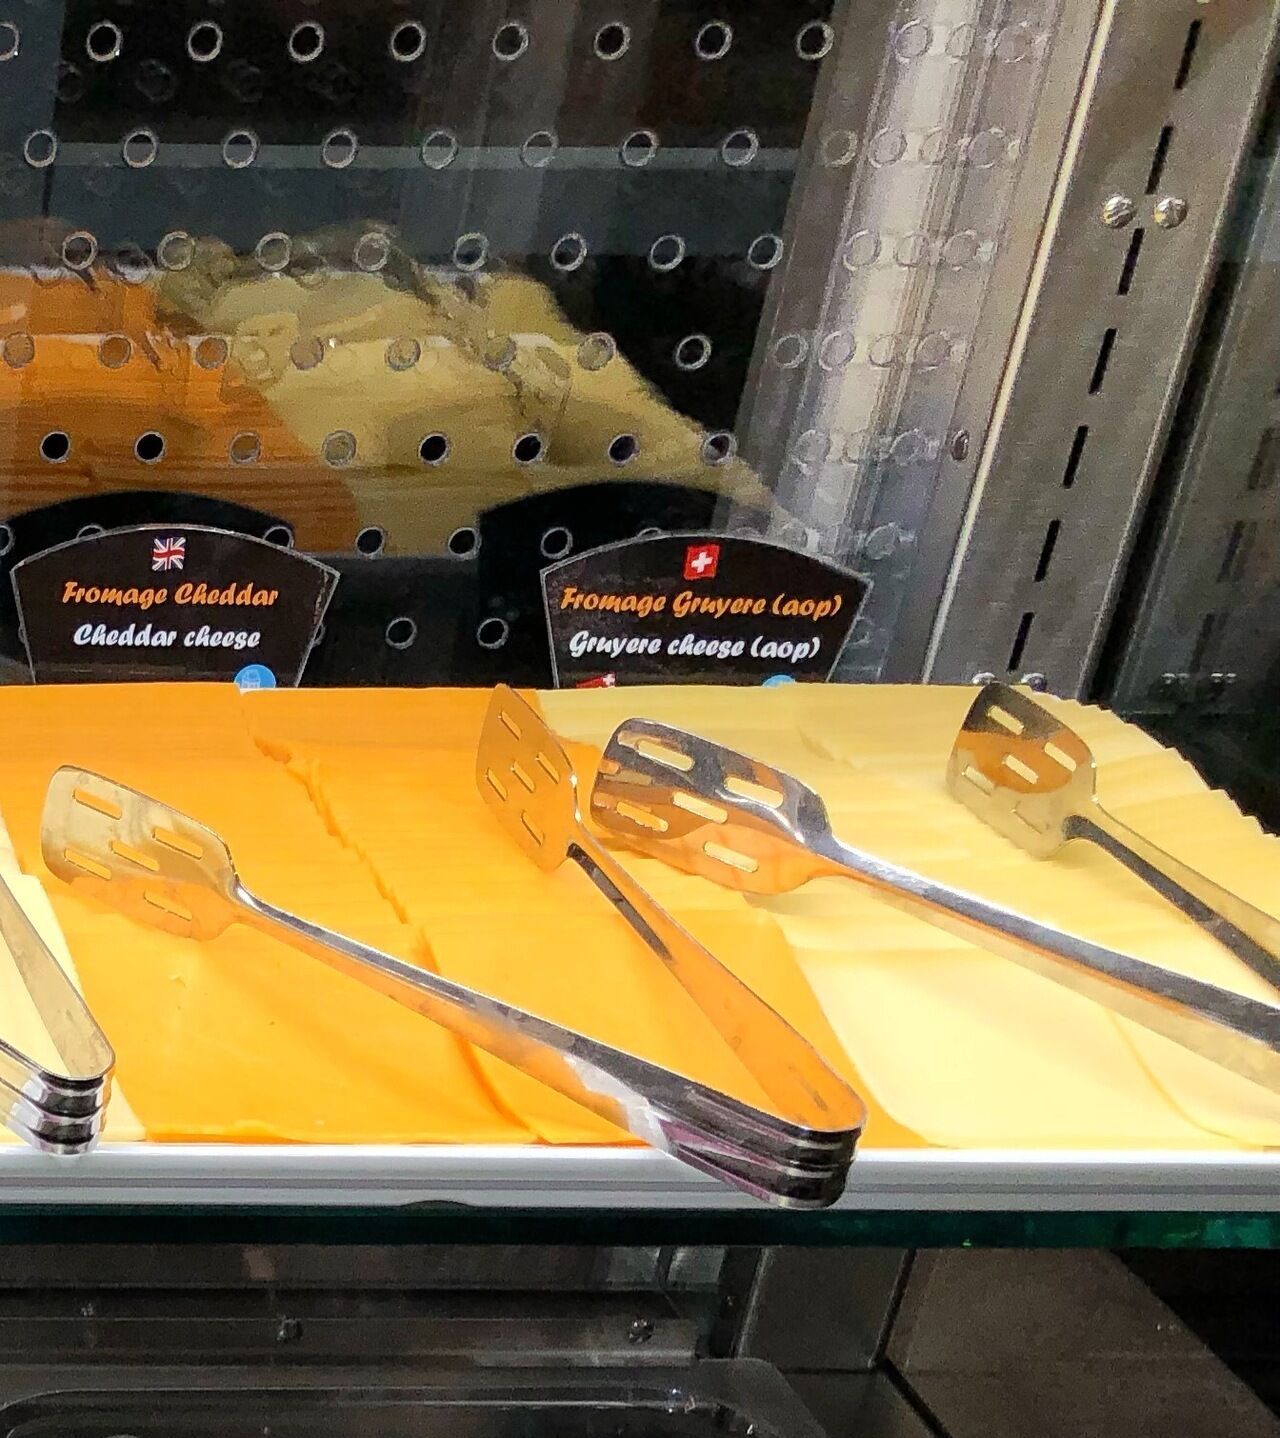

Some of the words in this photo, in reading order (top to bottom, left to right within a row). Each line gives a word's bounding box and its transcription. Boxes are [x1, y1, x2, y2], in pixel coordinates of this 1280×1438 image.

[62, 581, 168, 610] Fromage
[174, 582, 279, 606] Cheddar
[560, 587, 667, 618] Fromage
[673, 590, 766, 619] Gruyere
[772, 593, 842, 621] (aop)
[73, 623, 177, 647] Cheddar
[184, 625, 261, 650] cheese
[569, 630, 661, 659] Gruyere
[668, 634, 743, 659] cheese
[750, 636, 821, 663] (aop)
